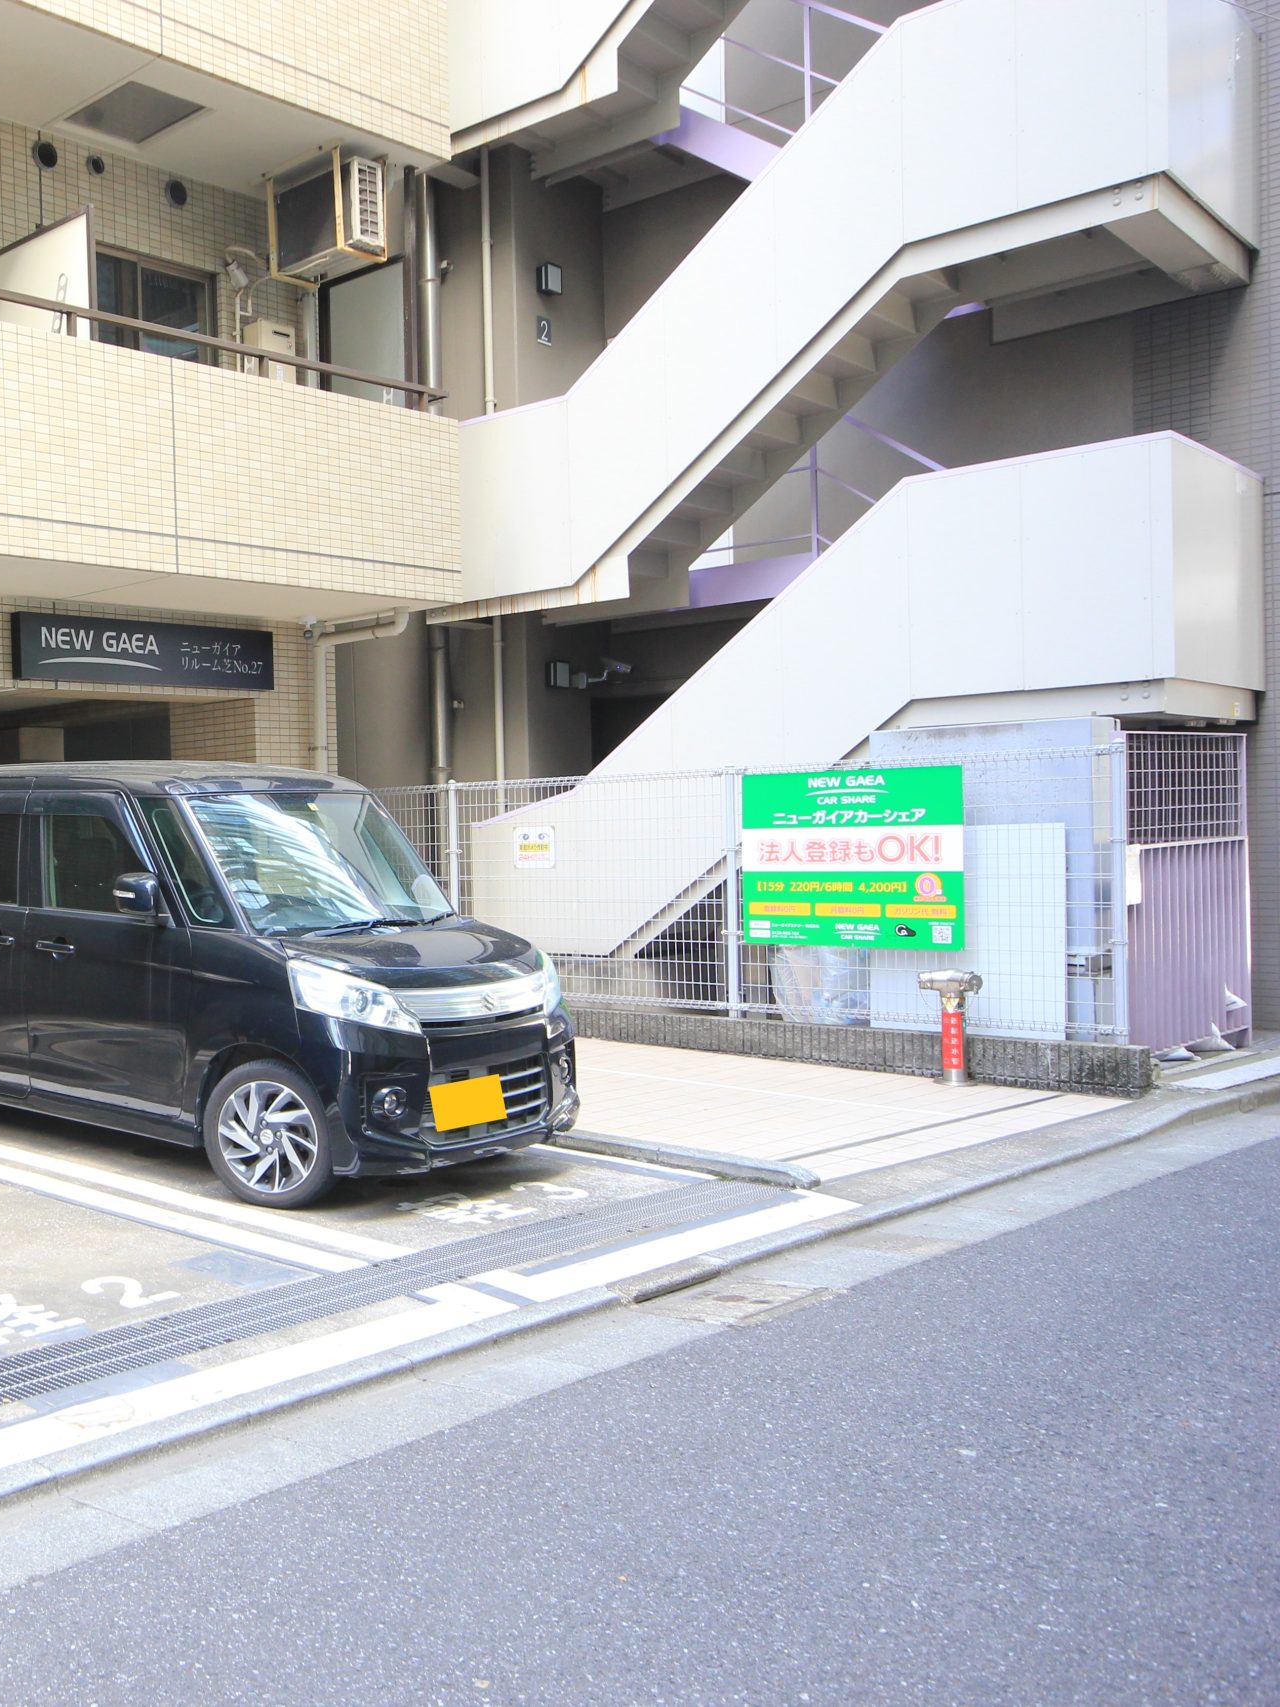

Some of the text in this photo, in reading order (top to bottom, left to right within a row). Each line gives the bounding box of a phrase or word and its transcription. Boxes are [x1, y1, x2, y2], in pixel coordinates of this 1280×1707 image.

[540, 320, 549, 341] 2
[41, 626, 160, 655] NEW GAEA
[180, 642, 241, 656] ニューガイア
[807, 774, 886, 788] NEW GAEA
[816, 794, 876, 805] CAR SHARE
[772, 808, 926, 825] ニューガイアカーシェア
[835, 923, 880, 931] NEW GAEA
[510, 1181, 590, 1200] 3
[80, 1275, 181, 1309] 2
